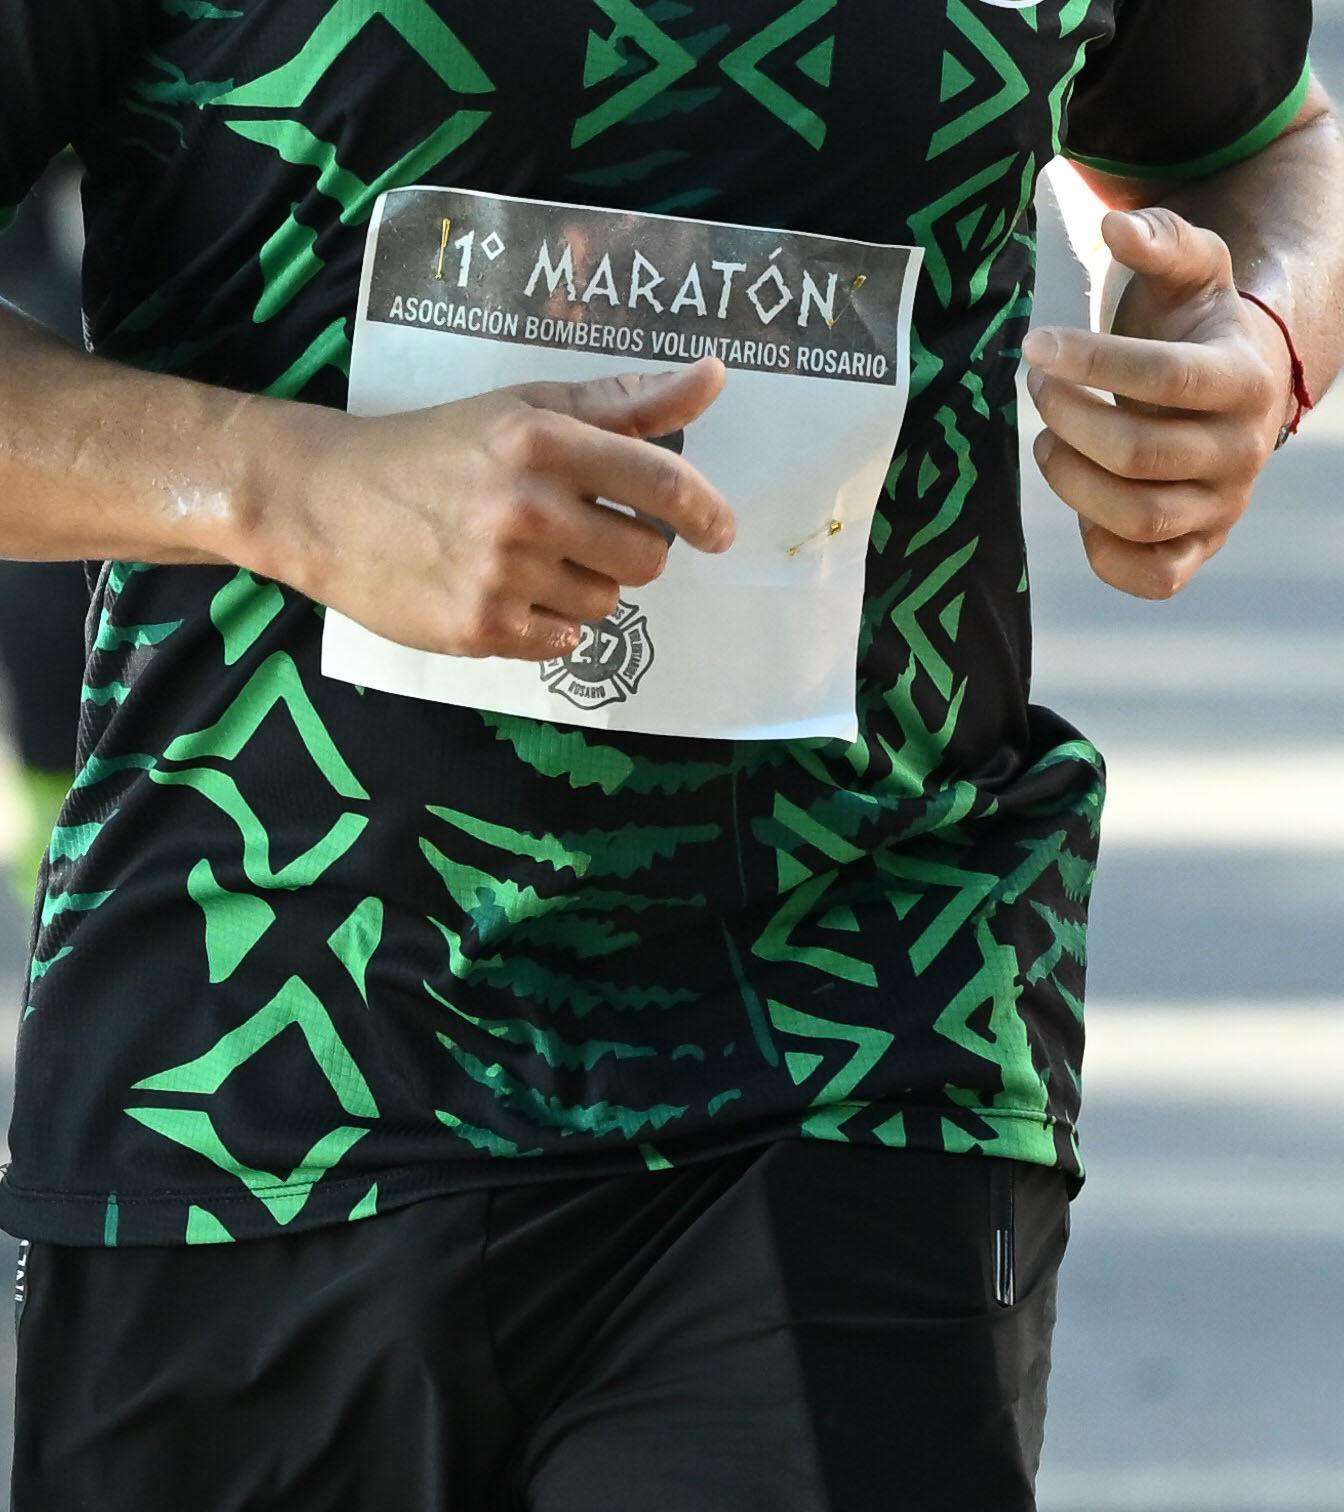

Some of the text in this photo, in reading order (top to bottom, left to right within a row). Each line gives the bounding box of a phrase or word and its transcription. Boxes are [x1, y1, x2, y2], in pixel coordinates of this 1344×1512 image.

[523, 238, 838, 328] MARATÓN
[389, 295, 887, 379] ASOCIACIÓN BOMBEROS VOLUNTARIOS ROSARIO
[570, 624, 619, 664] 27
